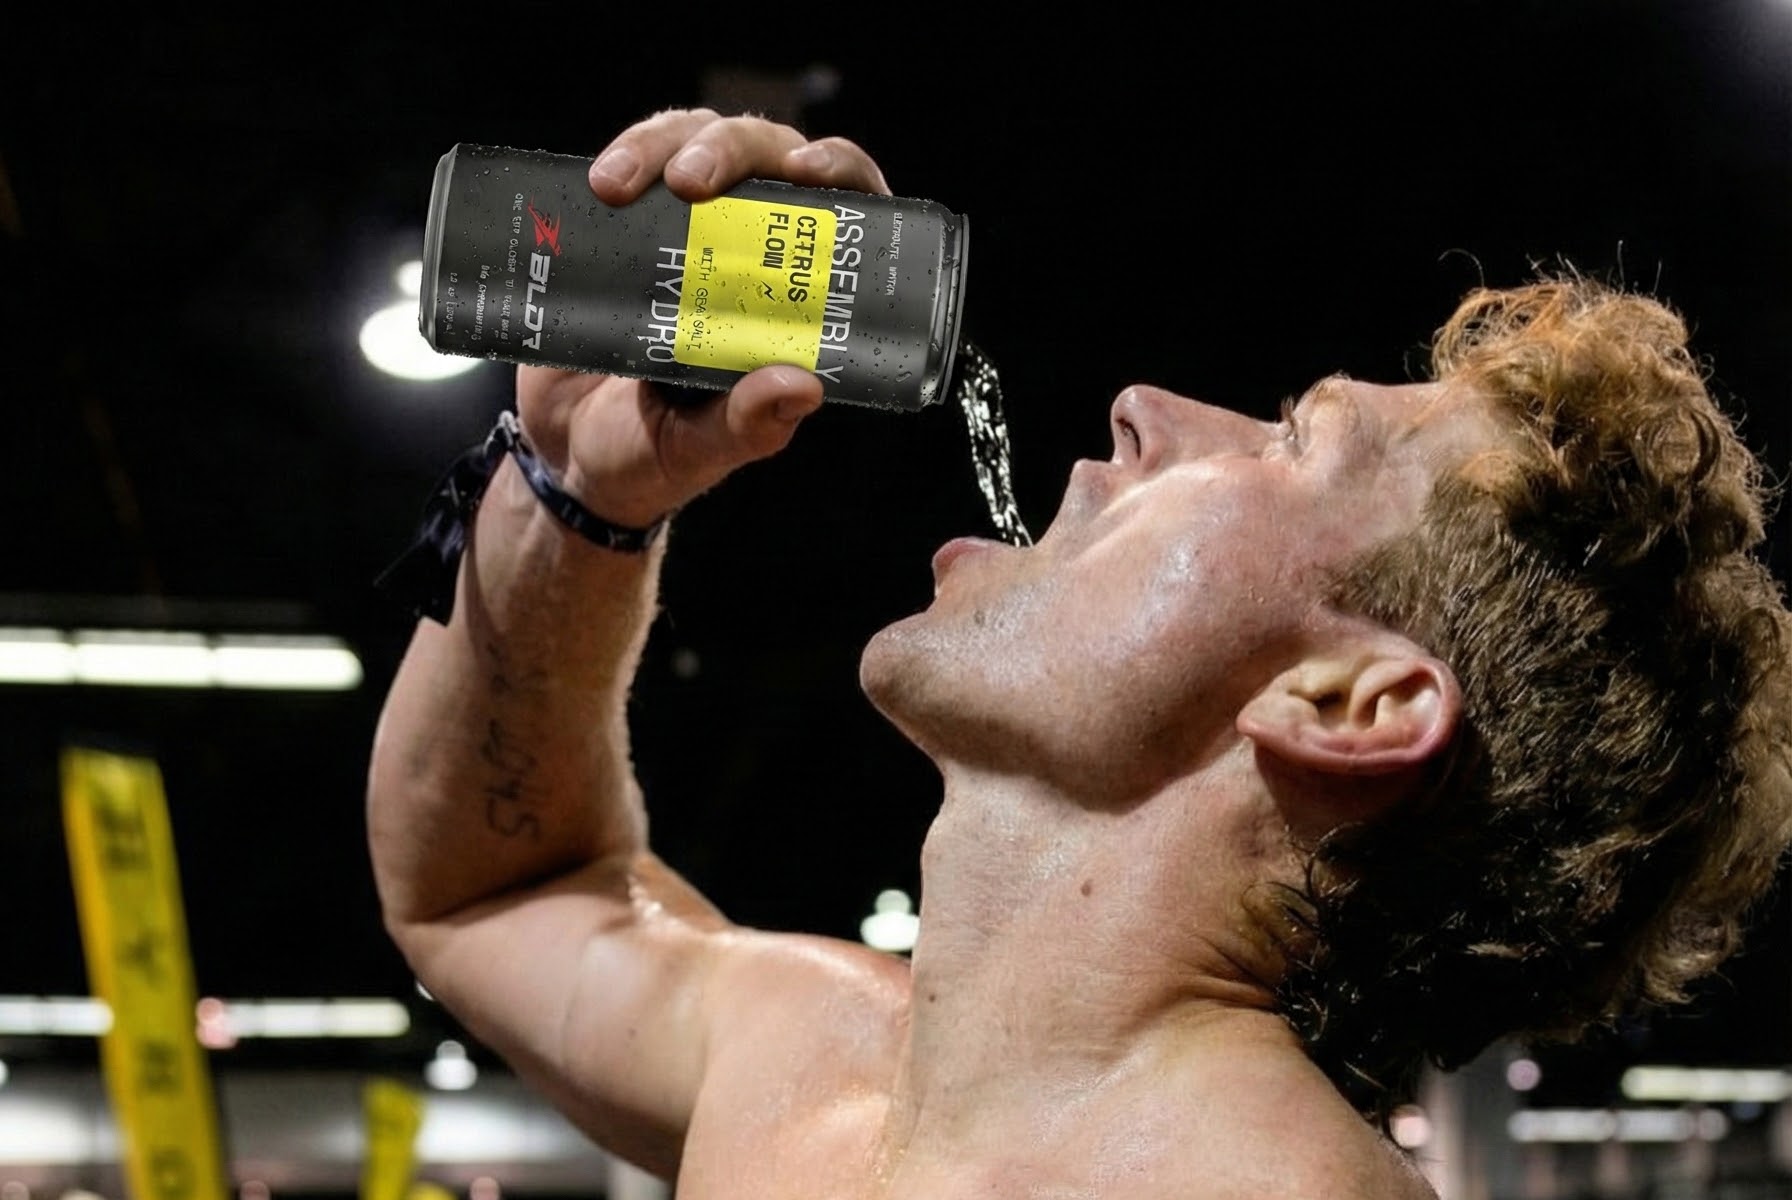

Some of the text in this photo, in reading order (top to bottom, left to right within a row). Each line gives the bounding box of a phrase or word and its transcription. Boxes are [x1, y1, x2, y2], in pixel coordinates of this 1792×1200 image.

[698, 247, 714, 281] WITH
[763, 212, 789, 269] FLOW
[788, 215, 817, 303] CITRUS
[522, 252, 550, 350] BLDR
[646, 247, 686, 363] HYDRO
